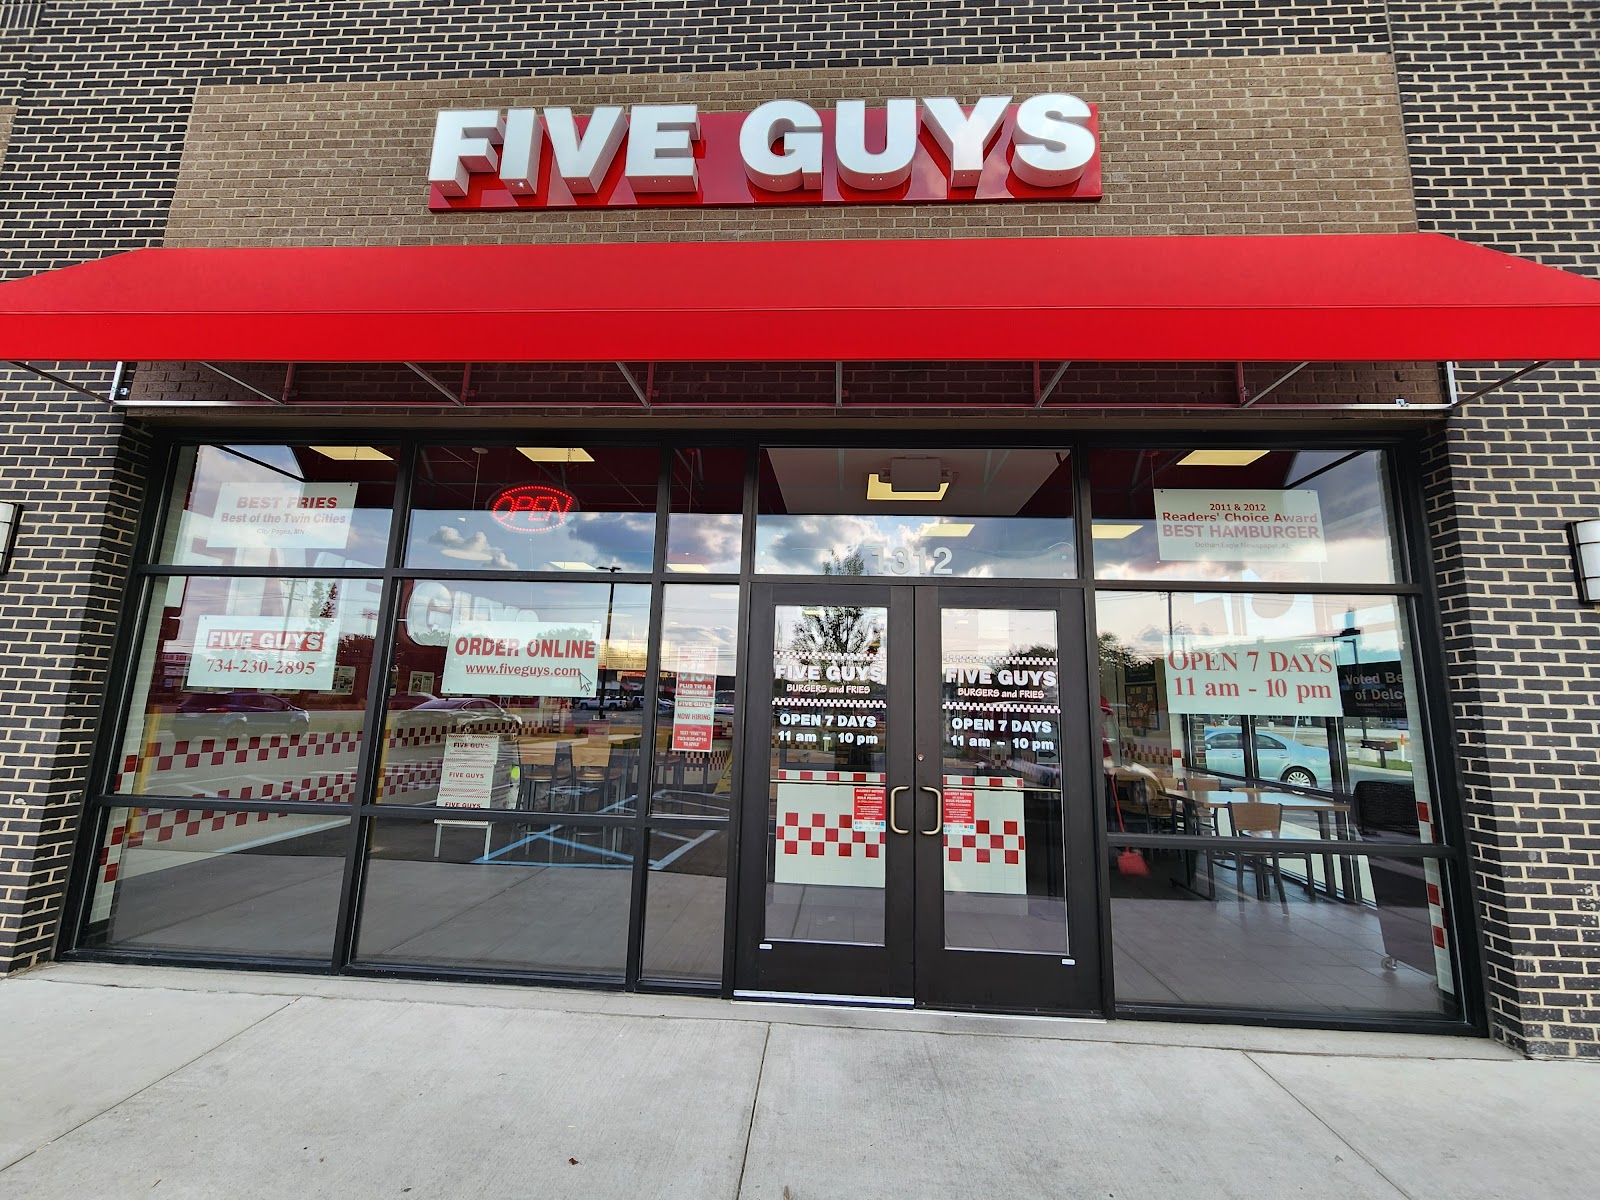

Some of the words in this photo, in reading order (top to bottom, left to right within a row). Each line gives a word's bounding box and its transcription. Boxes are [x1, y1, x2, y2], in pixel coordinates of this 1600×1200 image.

[428, 104, 702, 195] FIVE
[739, 92, 1097, 192] GUYS
[236, 496, 281, 509] BEST
[286, 496, 338, 509] FRIES
[491, 494, 574, 522] OPEN
[1209, 503, 1232, 512] 2011
[1233, 503, 1241, 511] &
[1243, 503, 1266, 512] 2012
[220, 512, 247, 523] Best
[249, 513, 261, 523] of
[260, 513, 281, 523] the
[284, 513, 311, 523] Twin
[313, 513, 346, 524] Cities
[1162, 511, 1220, 522] Readers'
[1224, 512, 1270, 523] Choice
[1273, 513, 1318, 523] Award
[256, 528, 269, 536] City
[1162, 524, 1204, 538] BEST
[1209, 525, 1321, 539] HAMBURGER
[871, 546, 953, 575] 1312
[208, 630, 254, 649] FIVE
[259, 632, 323, 651] GUYS
[455, 637, 520, 657] ORDER
[526, 639, 596, 659] ONLINE
[205, 658, 316, 675] 734-230-2895
[1167, 651, 1239, 671] OPEN
[1246, 652, 1260, 672] 7
[1270, 652, 1333, 673] DAYS
[465, 663, 582, 678] www.fiveguys.com
[775, 664, 821, 681] FIVE
[826, 665, 883, 682] GUYS
[945, 668, 993, 685] FIVE
[998, 669, 1057, 687] GUYS
[1345, 672, 1380, 685] Voted
[786, 683, 828, 693] BURGERS
[828, 685, 844, 694] and
[846, 685, 871, 695] FRIES
[957, 687, 1000, 697] BURGERS
[1001, 689, 1018, 698] and
[1020, 689, 1045, 699] FRIES
[1174, 677, 1196, 697] 11
[1205, 682, 1240, 698] am
[1265, 678, 1288, 698] 10
[1296, 683, 1333, 704] pm
[1354, 688, 1367, 700] of
[1371, 688, 1405, 700] Delc
[779, 713, 821, 727] OPEN
[825, 714, 834, 727] 7
[837, 715, 877, 728] DAYS
[951, 717, 995, 731] OPEN
[998, 719, 1008, 732] 7
[1011, 720, 1052, 734] DAYS
[777, 731, 792, 742] 11
[795, 732, 817, 743] am
[838, 732, 854, 744] 10
[856, 734, 879, 746] pm
[950, 735, 965, 747] 11
[969, 738, 991, 748] am
[1012, 737, 1029, 749] 10
[1032, 739, 1055, 752] pm
